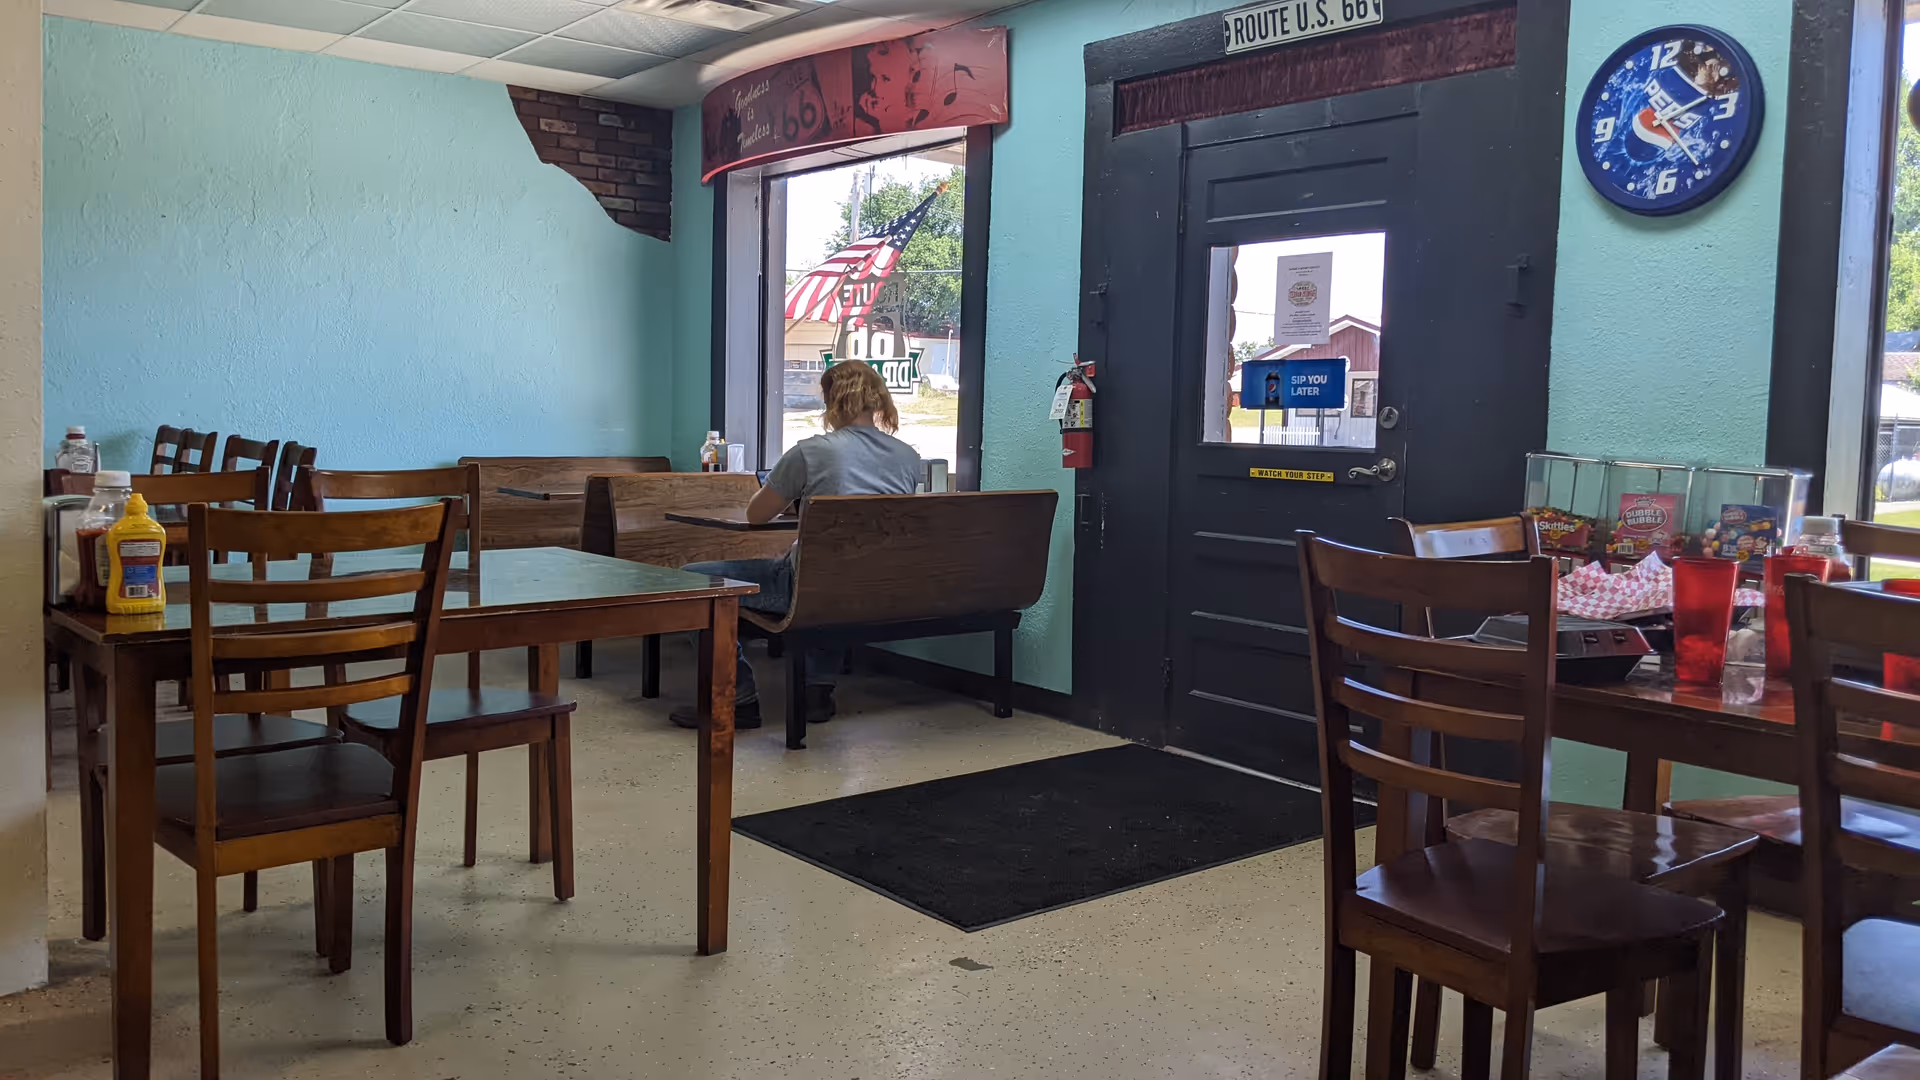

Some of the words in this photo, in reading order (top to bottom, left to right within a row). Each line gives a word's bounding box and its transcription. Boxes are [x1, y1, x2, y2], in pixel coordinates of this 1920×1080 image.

[1234, 6, 1290, 45] ROUTE
[1297, 0, 1334, 32] U.S.
[1342, 0, 1368, 22] 66
[1650, 40, 1684, 71] 12
[735, 80, 769, 119] Goodness
[1713, 92, 1739, 121] 3
[747, 107, 754, 121] is
[782, 90, 817, 141] 66
[737, 123, 769, 153] Timeless
[1594, 116, 1616, 144] 9
[1655, 168, 1678, 195] 6
[1291, 375, 1306, 385] SIP
[1308, 374, 1328, 385] YOU
[1291, 386, 1320, 396] LATER
[1257, 469, 1282, 478] WATCH
[1285, 471, 1304, 479] YOUR
[1306, 472, 1325, 480] STEP
[1538, 521, 1576, 532] Skittles
[1626, 509, 1662, 518] DUBBLE
[1626, 517, 1663, 526] BUBBLE
